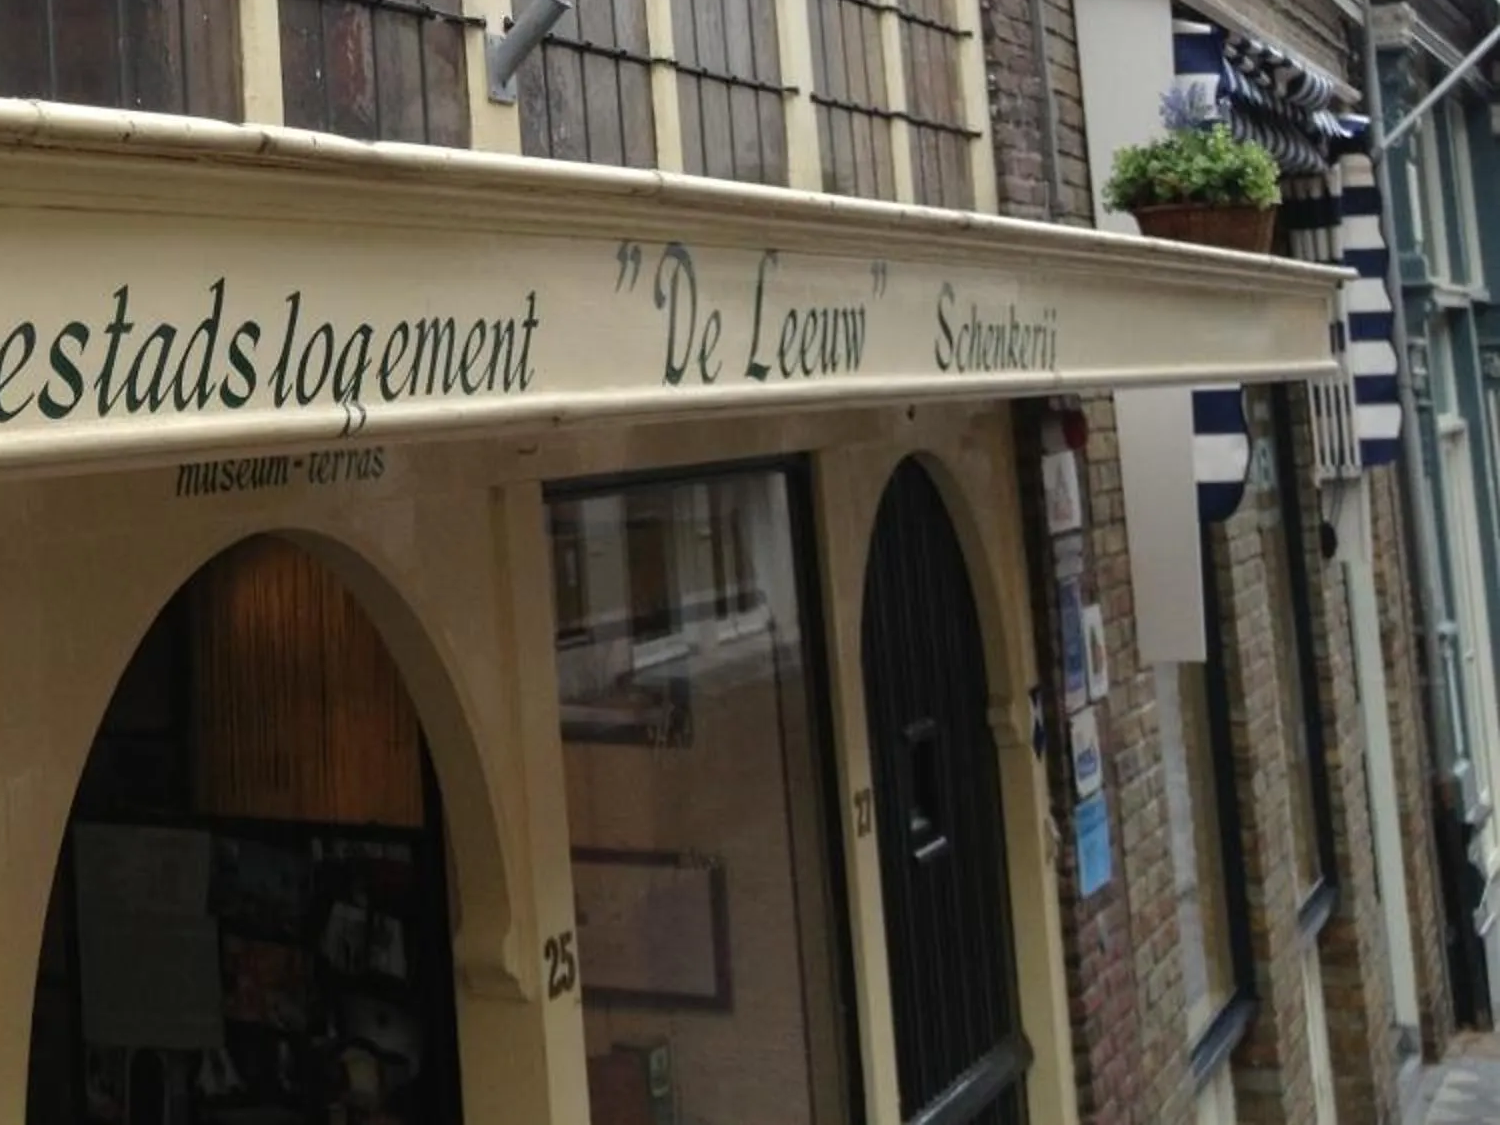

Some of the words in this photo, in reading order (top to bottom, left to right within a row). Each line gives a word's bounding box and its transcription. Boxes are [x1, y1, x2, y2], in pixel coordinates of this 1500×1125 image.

[934, 282, 1057, 372] Schenkerij
[854, 788, 871, 838] 27
[544, 931, 576, 1002] 25
